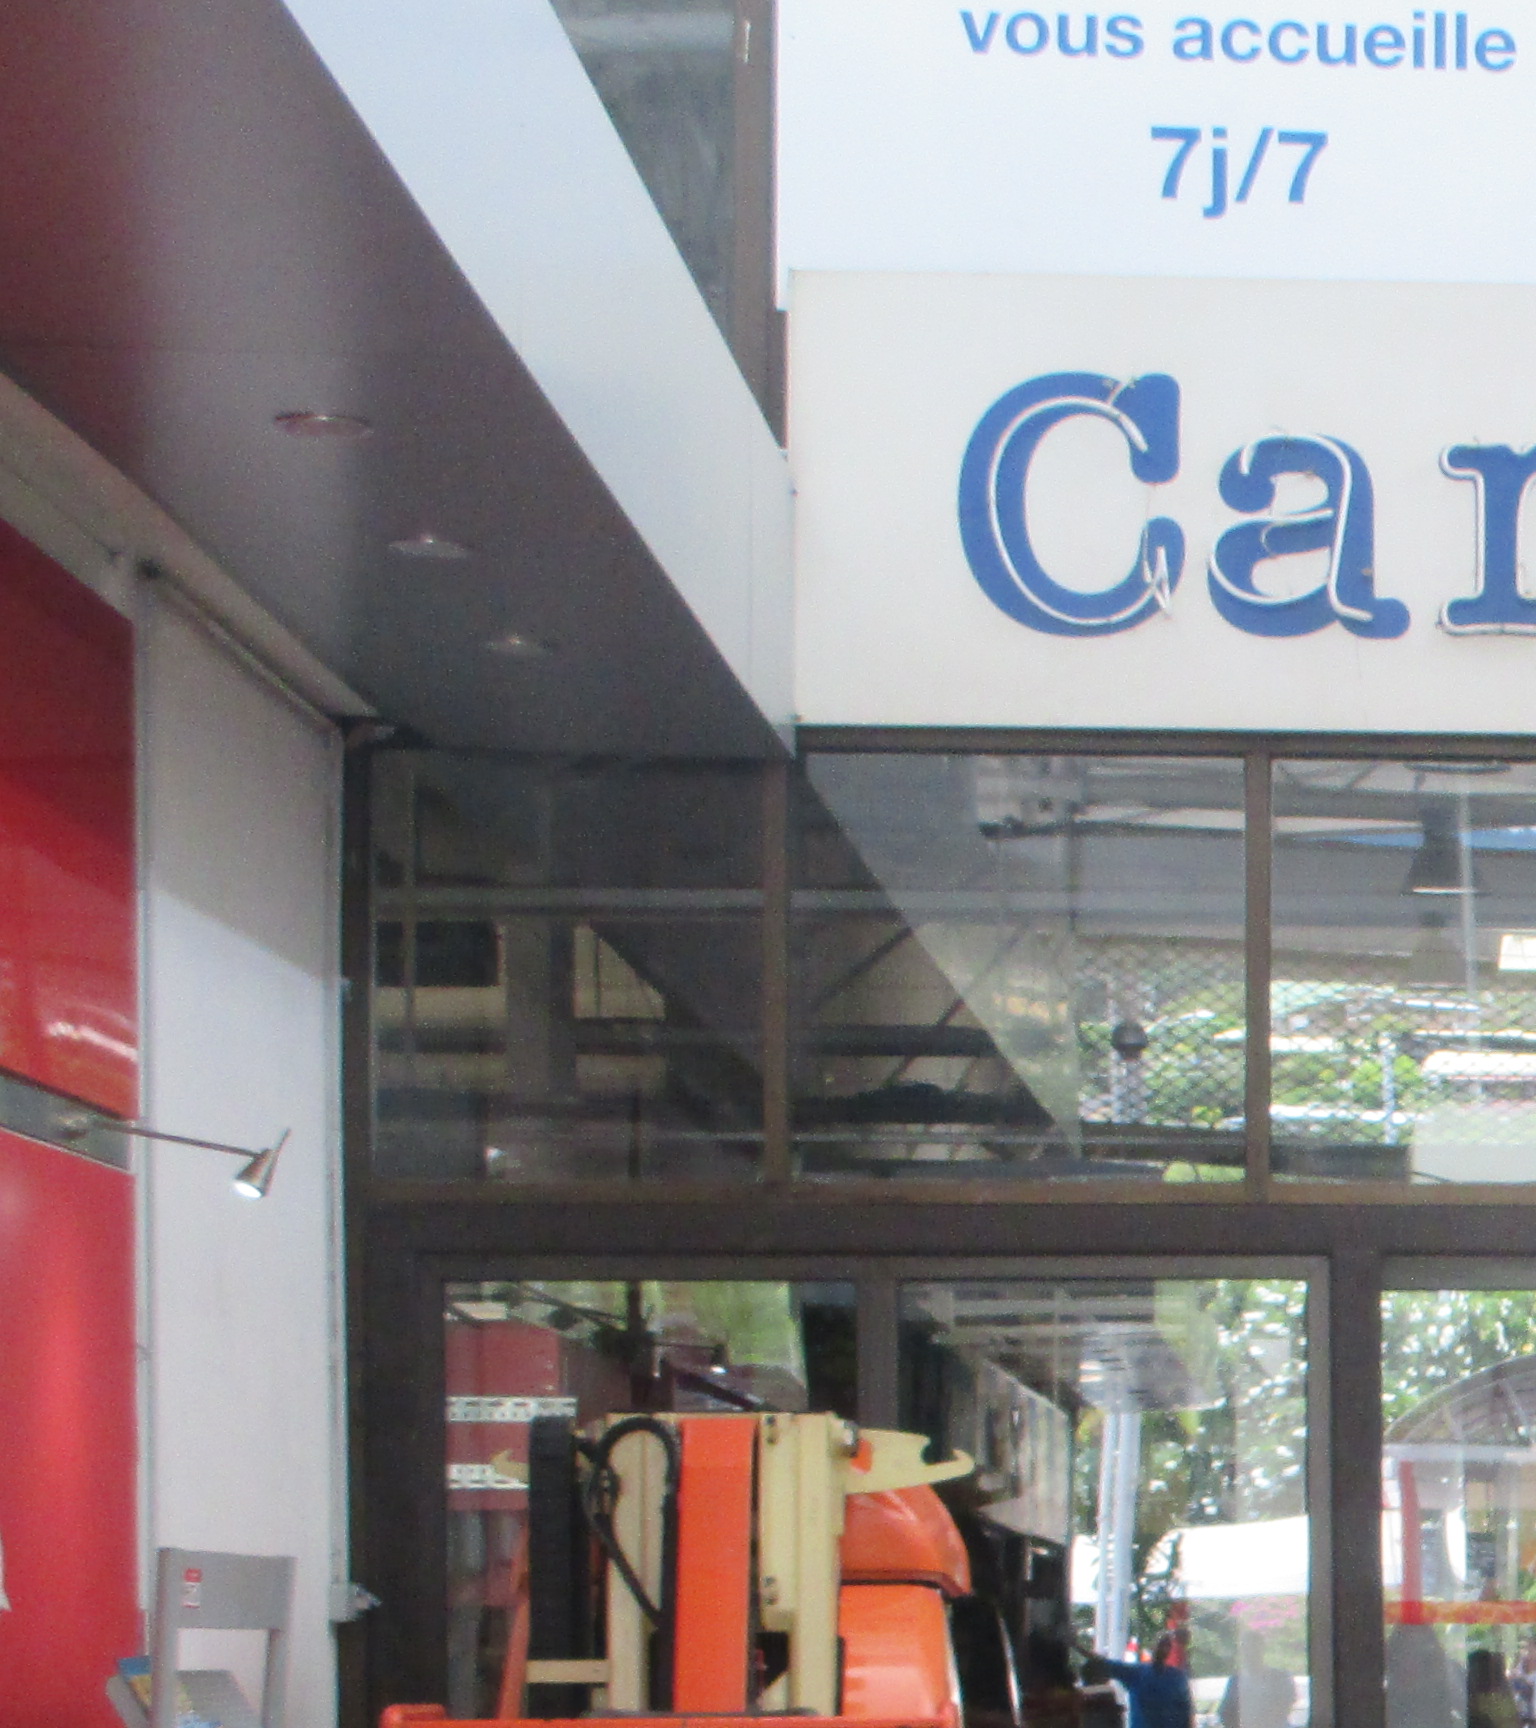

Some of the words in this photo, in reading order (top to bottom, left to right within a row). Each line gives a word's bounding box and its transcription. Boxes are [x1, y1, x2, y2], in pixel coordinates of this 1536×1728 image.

[957, 9, 1146, 59] vous
[1170, 9, 1519, 72] accueille
[1148, 122, 1330, 219] 7j/7
